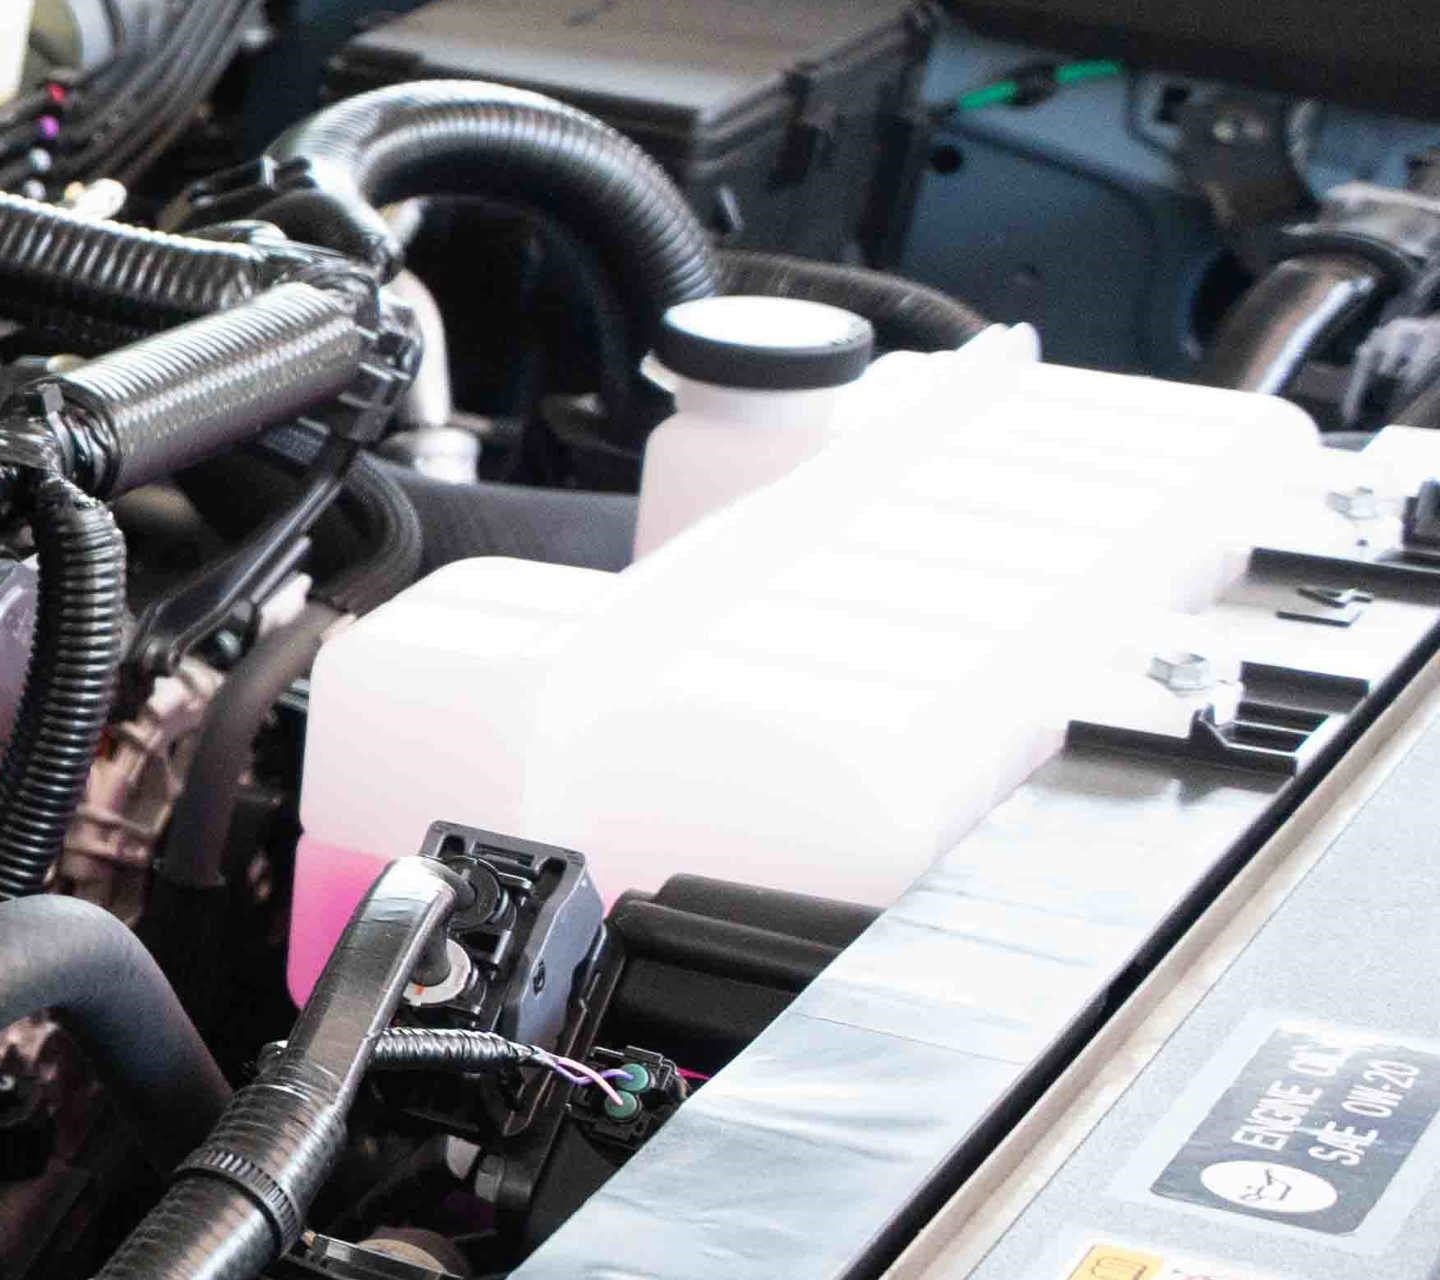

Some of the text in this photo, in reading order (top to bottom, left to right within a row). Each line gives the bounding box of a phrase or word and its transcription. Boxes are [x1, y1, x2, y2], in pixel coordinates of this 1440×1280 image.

[1231, 1079, 1324, 1151] ENGINE
[1308, 1058, 1421, 1166] SAE 0W-20
